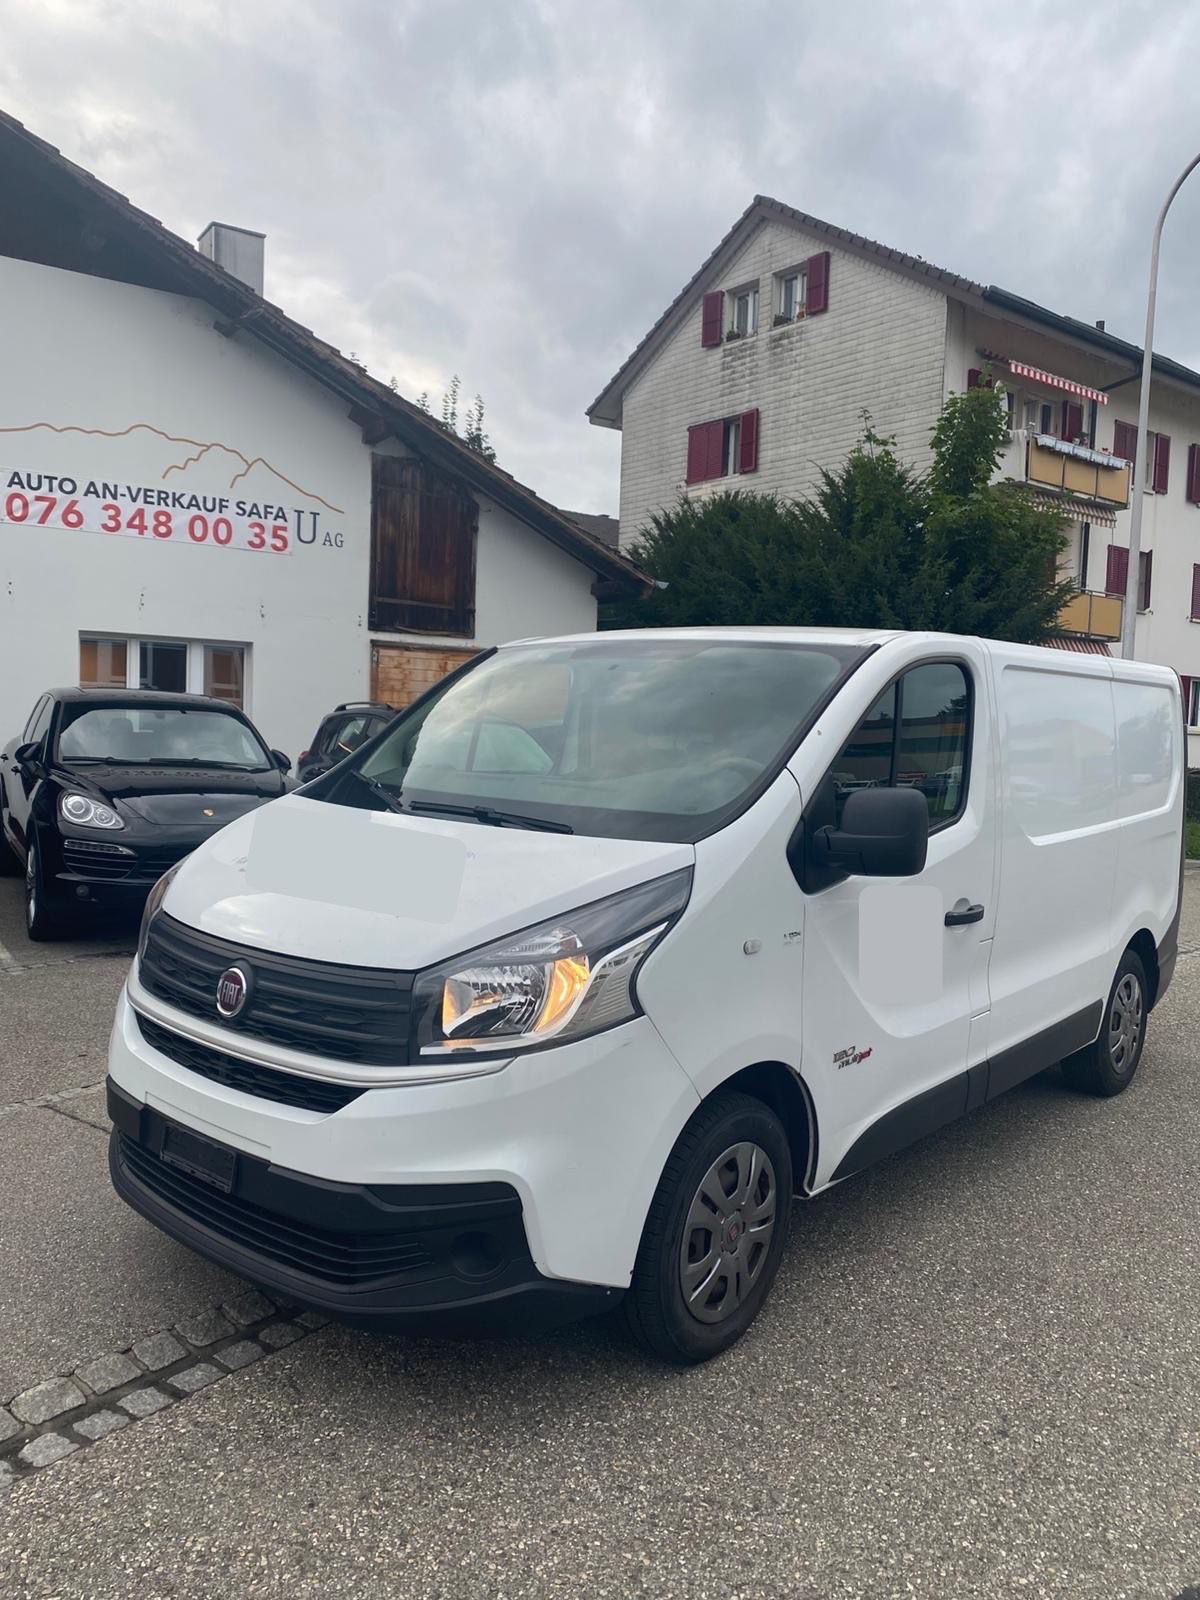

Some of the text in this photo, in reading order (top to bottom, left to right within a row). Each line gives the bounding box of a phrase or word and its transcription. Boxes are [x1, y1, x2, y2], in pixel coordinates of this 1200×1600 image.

[7, 471, 288, 522] AUTO AN-VERKAUF SAFA
[5, 492, 288, 552] 076 348 00 35
[294, 510, 344, 548] U AG
[221, 980, 240, 1005] FIAT
